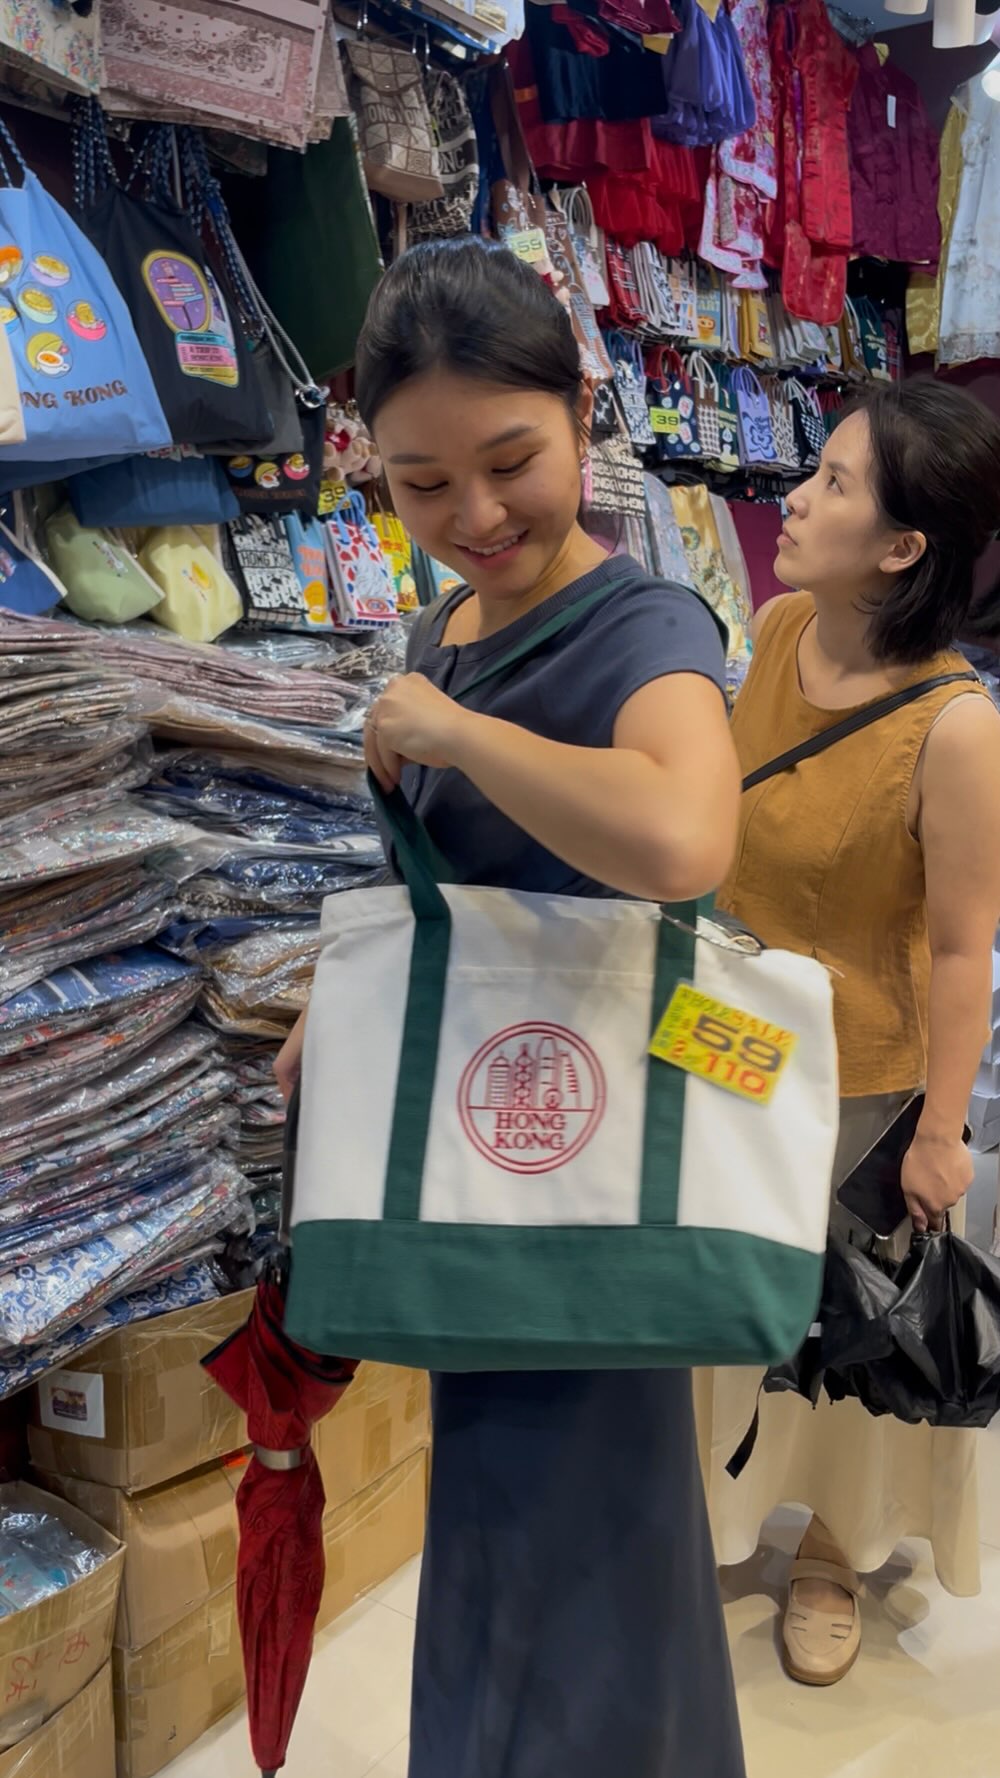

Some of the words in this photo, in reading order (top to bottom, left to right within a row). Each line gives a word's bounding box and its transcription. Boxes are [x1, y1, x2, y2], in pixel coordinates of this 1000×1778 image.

[516, 239, 543, 253] 59
[20, 391, 58, 409] NG
[63, 379, 128, 407] KONG
[655, 414, 679, 426] 39
[320, 486, 346, 503] 39
[240, 551, 271, 567] HONG
[692, 1013, 783, 1073] 59
[704, 1053, 767, 1094] 110
[495, 1111, 567, 1130] HONG
[493, 1131, 566, 1150] KONG
